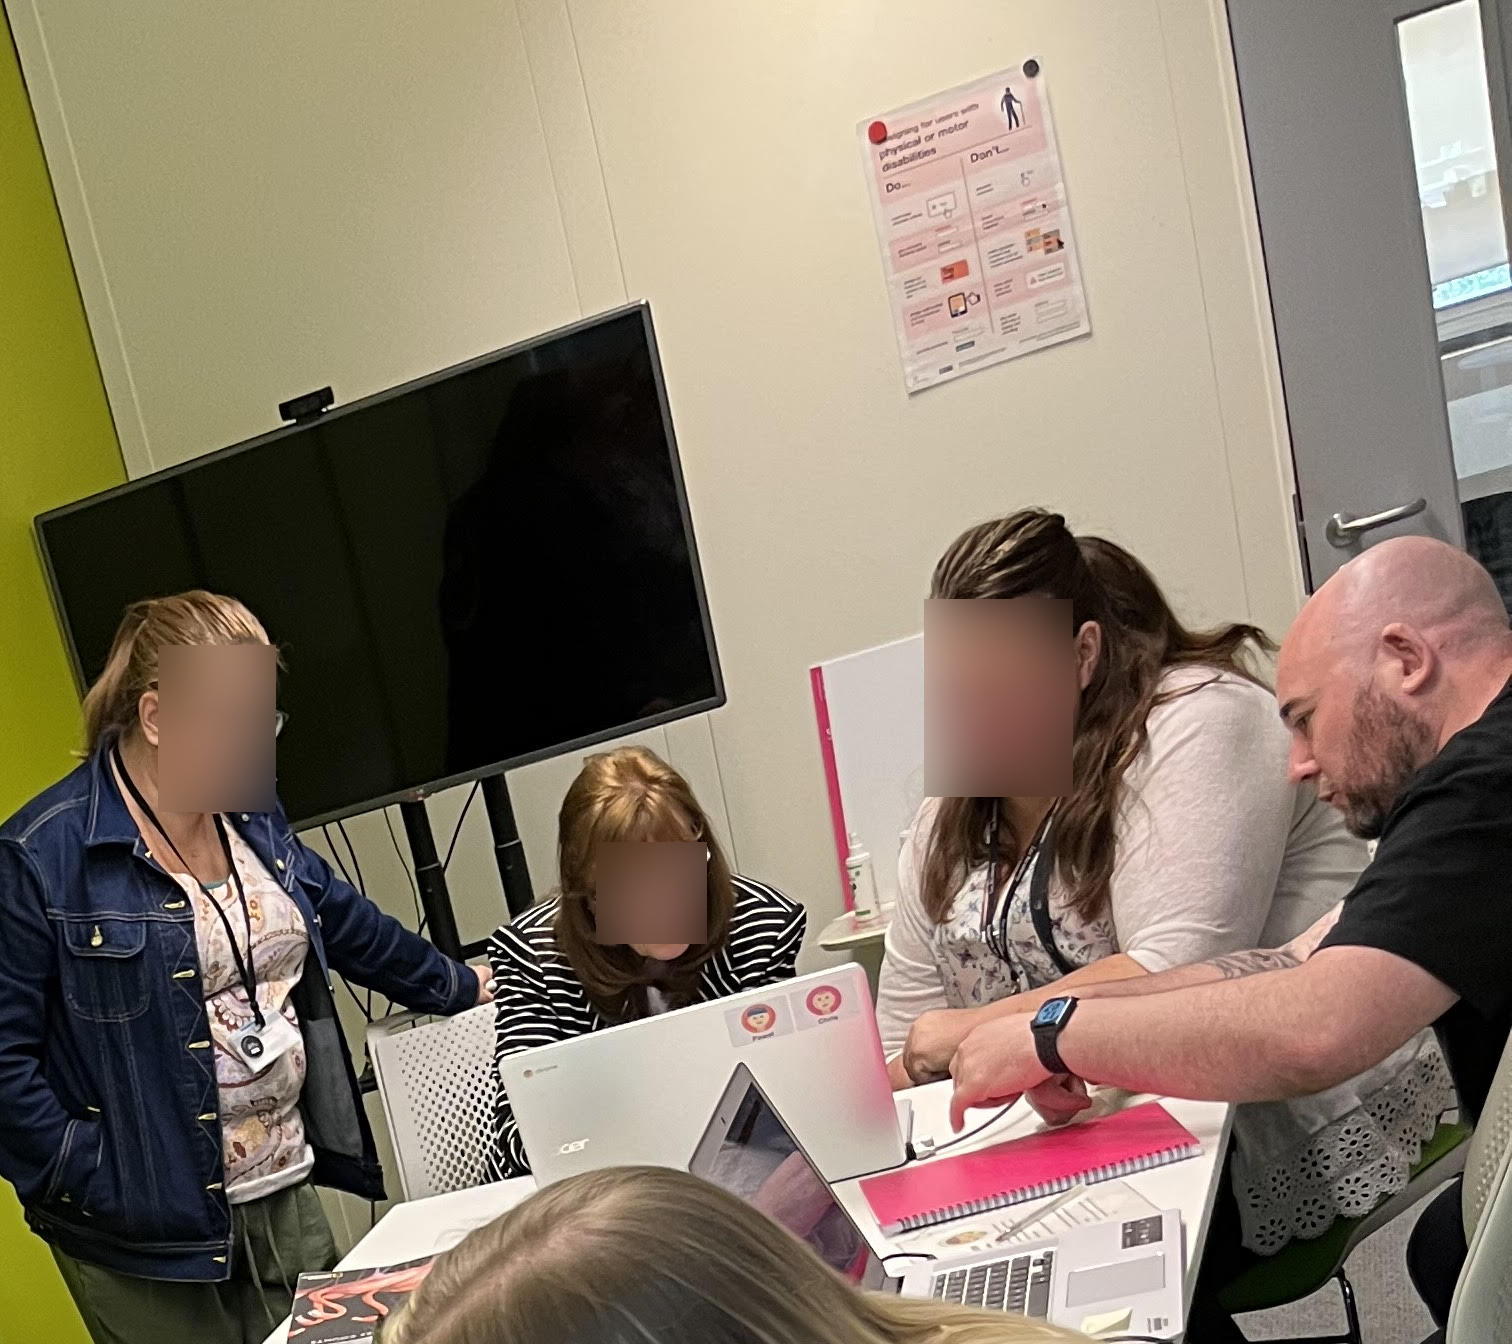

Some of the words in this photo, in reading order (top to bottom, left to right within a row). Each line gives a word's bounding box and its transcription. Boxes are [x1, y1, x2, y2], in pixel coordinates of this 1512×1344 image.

[879, 136, 921, 161] physical
[925, 132, 935, 143] or
[938, 120, 969, 138] motor
[882, 147, 936, 173] disabilities
[553, 1138, 590, 1155] cer
